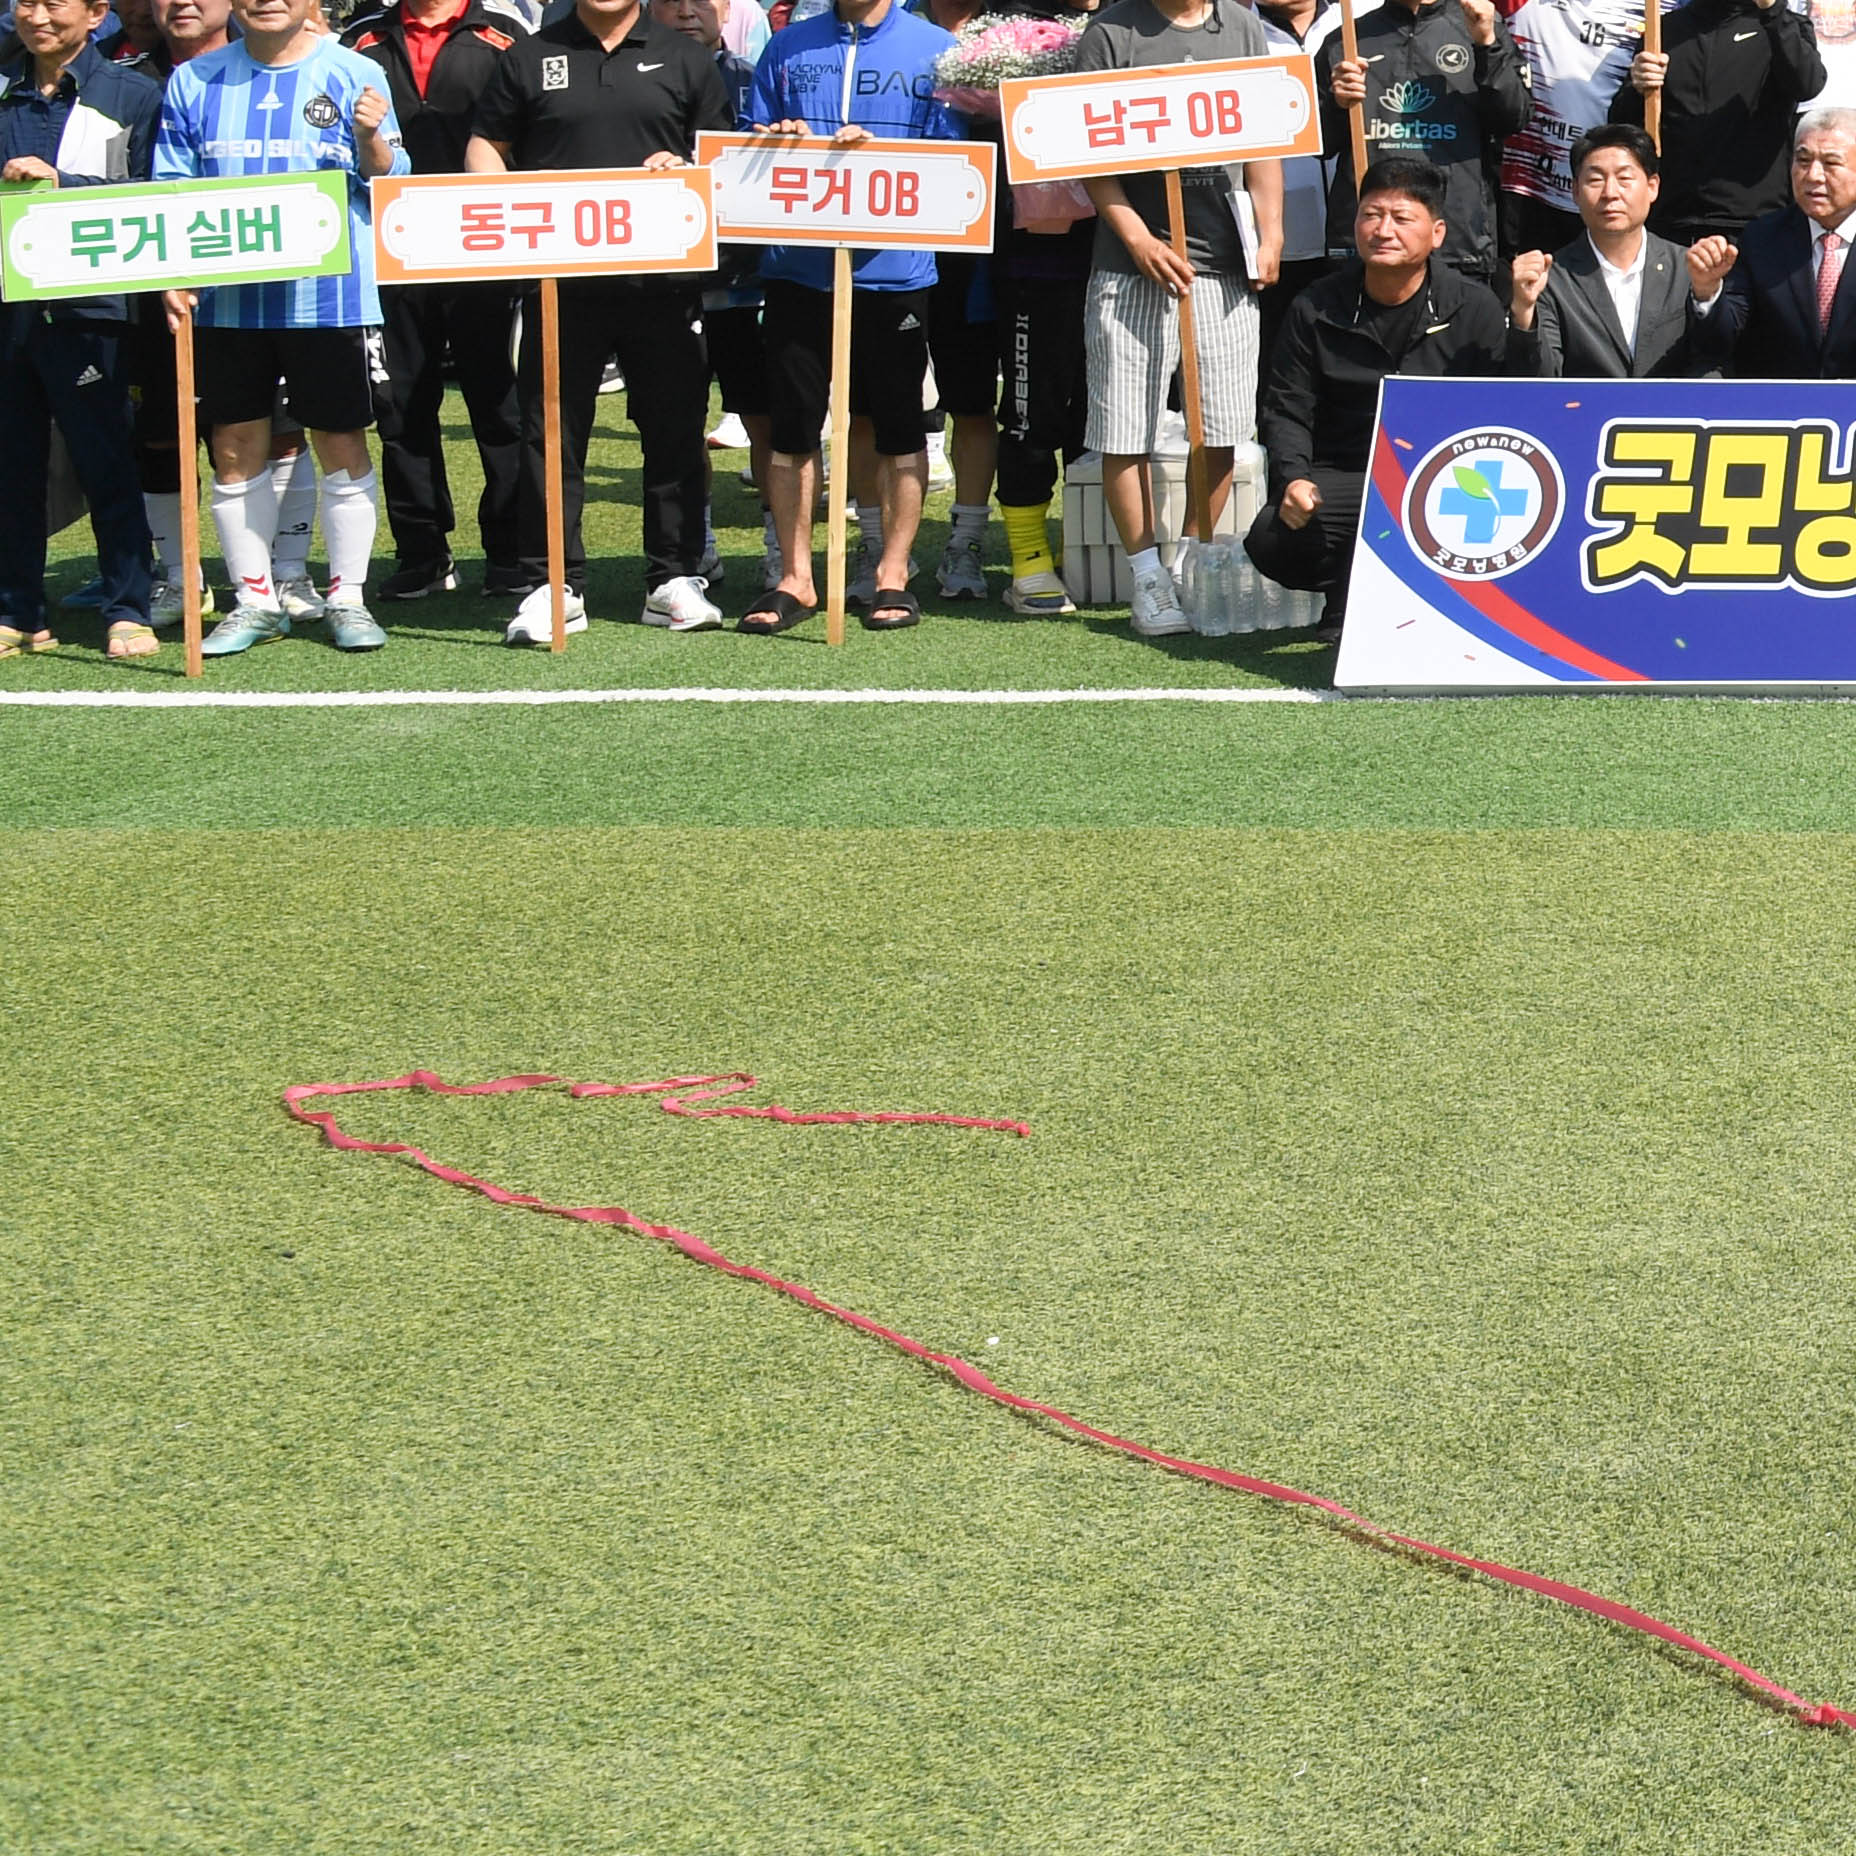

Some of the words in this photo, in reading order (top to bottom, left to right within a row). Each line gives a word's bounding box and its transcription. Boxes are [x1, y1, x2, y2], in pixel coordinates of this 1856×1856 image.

[1084, 96, 1171, 148] 남구
[1187, 90, 1242, 137] OB
[770, 167, 851, 215] 무거
[868, 170, 919, 216] OB
[71, 214, 166, 267] 무거
[187, 205, 282, 258] 실버
[461, 202, 555, 251] 동구
[575, 200, 632, 246] OB
